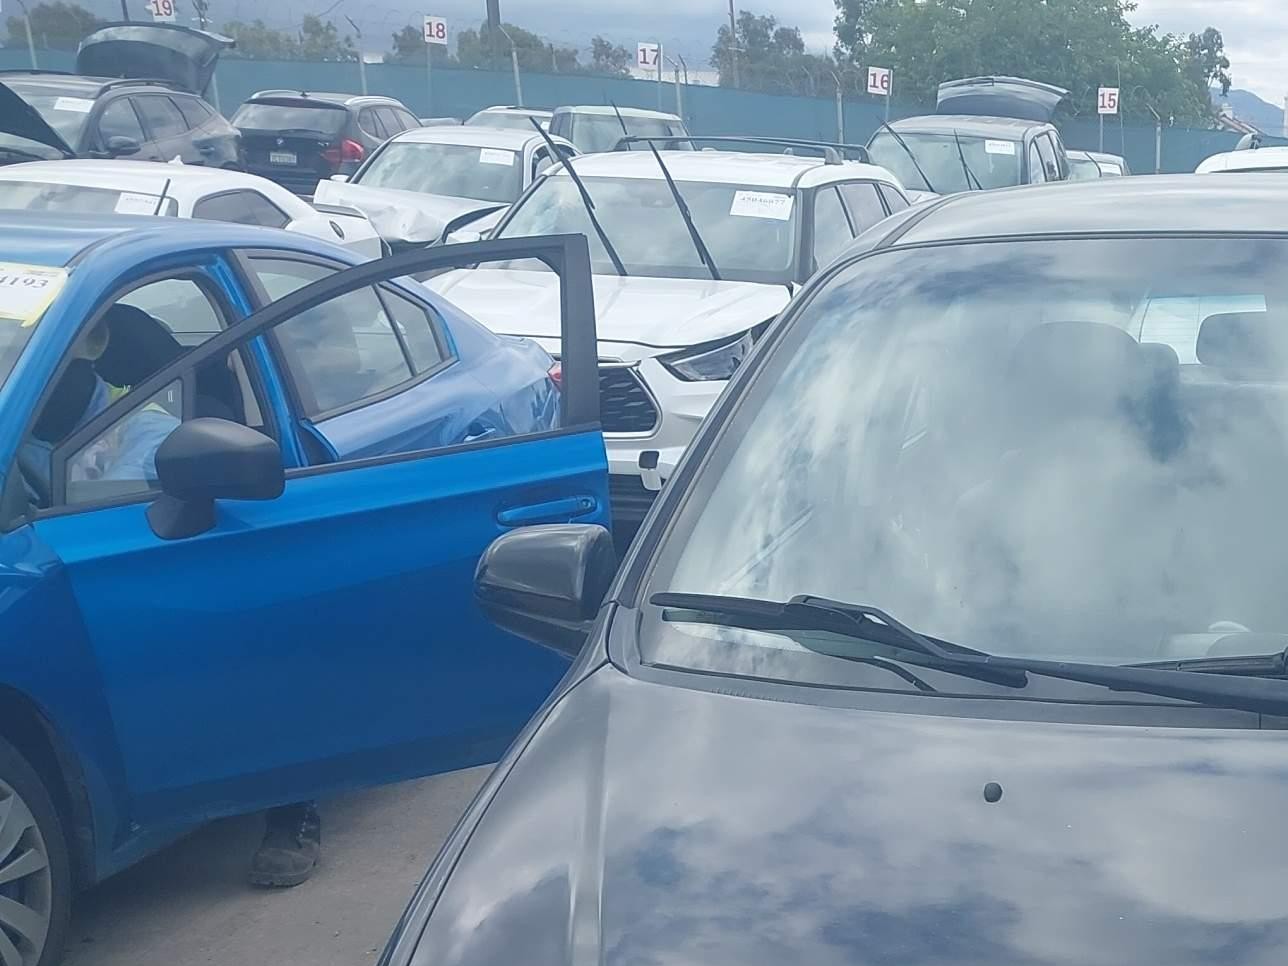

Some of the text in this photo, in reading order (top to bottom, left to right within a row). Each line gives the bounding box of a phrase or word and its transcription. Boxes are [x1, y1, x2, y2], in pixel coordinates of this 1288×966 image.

[153, 0, 172, 17] 19
[425, 22, 446, 39] 18
[639, 48, 659, 65] 17
[869, 72, 889, 90] 16
[1099, 92, 1117, 109] 15
